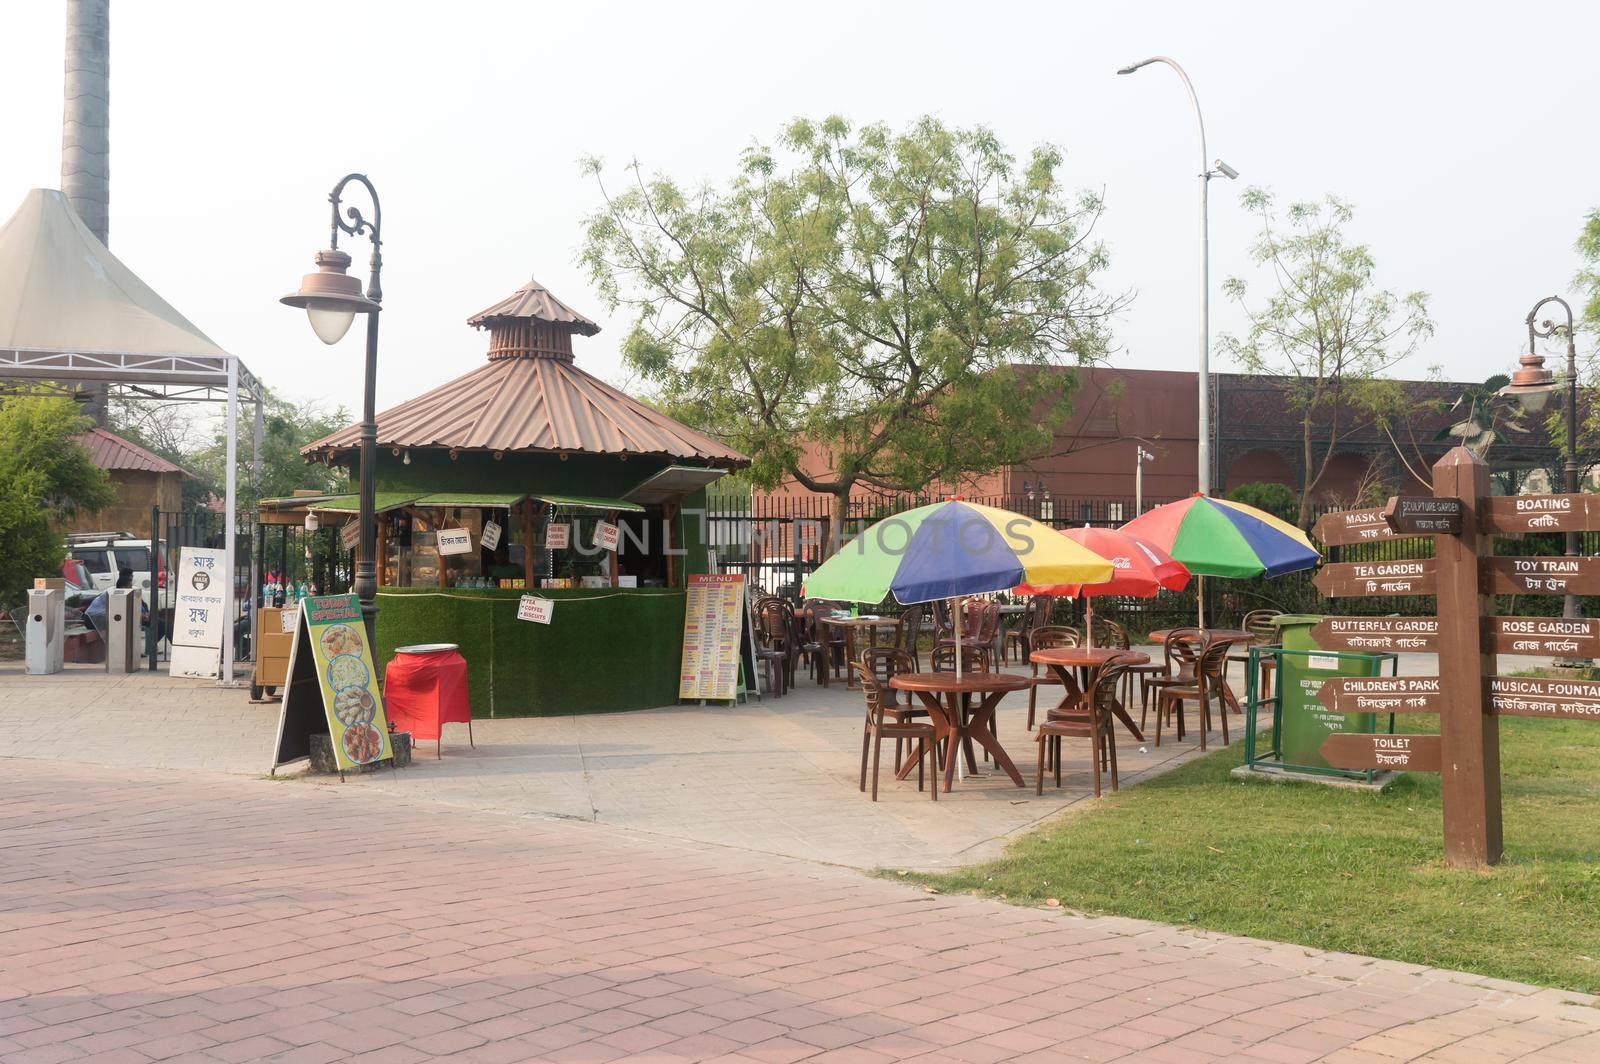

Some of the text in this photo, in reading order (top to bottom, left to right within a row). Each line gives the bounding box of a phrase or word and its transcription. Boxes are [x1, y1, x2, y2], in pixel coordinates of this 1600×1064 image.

[1516, 498, 1571, 510] BOATING
[1345, 512, 1377, 524] MASK
[1528, 514, 1560, 528] বোটিং
[1354, 564, 1424, 577] TEA GARDEN
[1515, 561, 1579, 571] TOY TRAIN
[1367, 579, 1411, 592] টি গার্ডেন
[1525, 577, 1567, 590] টয় ট্রেন
[314, 596, 351, 609] TODAY
[524, 605, 543, 613] COFFEE
[311, 607, 360, 621] SPECIAL
[523, 611, 546, 620] BISCUITS
[1331, 621, 1392, 632] BUTTERFLY
[1502, 621, 1590, 634] ROSE GARDEN
[1396, 636, 1428, 648] গার্ডেন
[1513, 639, 1579, 652] রোজ গার্ডেন
[1343, 679, 1440, 692] CHILDREN'S PARK
[1491, 681, 1600, 697] MUSICAL FOUNTAI
[1405, 695, 1427, 708] পার্ক
[1560, 701, 1600, 715] ফাউন্টে
[1373, 738, 1410, 748] TOILET
[1376, 753, 1409, 765] টয়লেট
